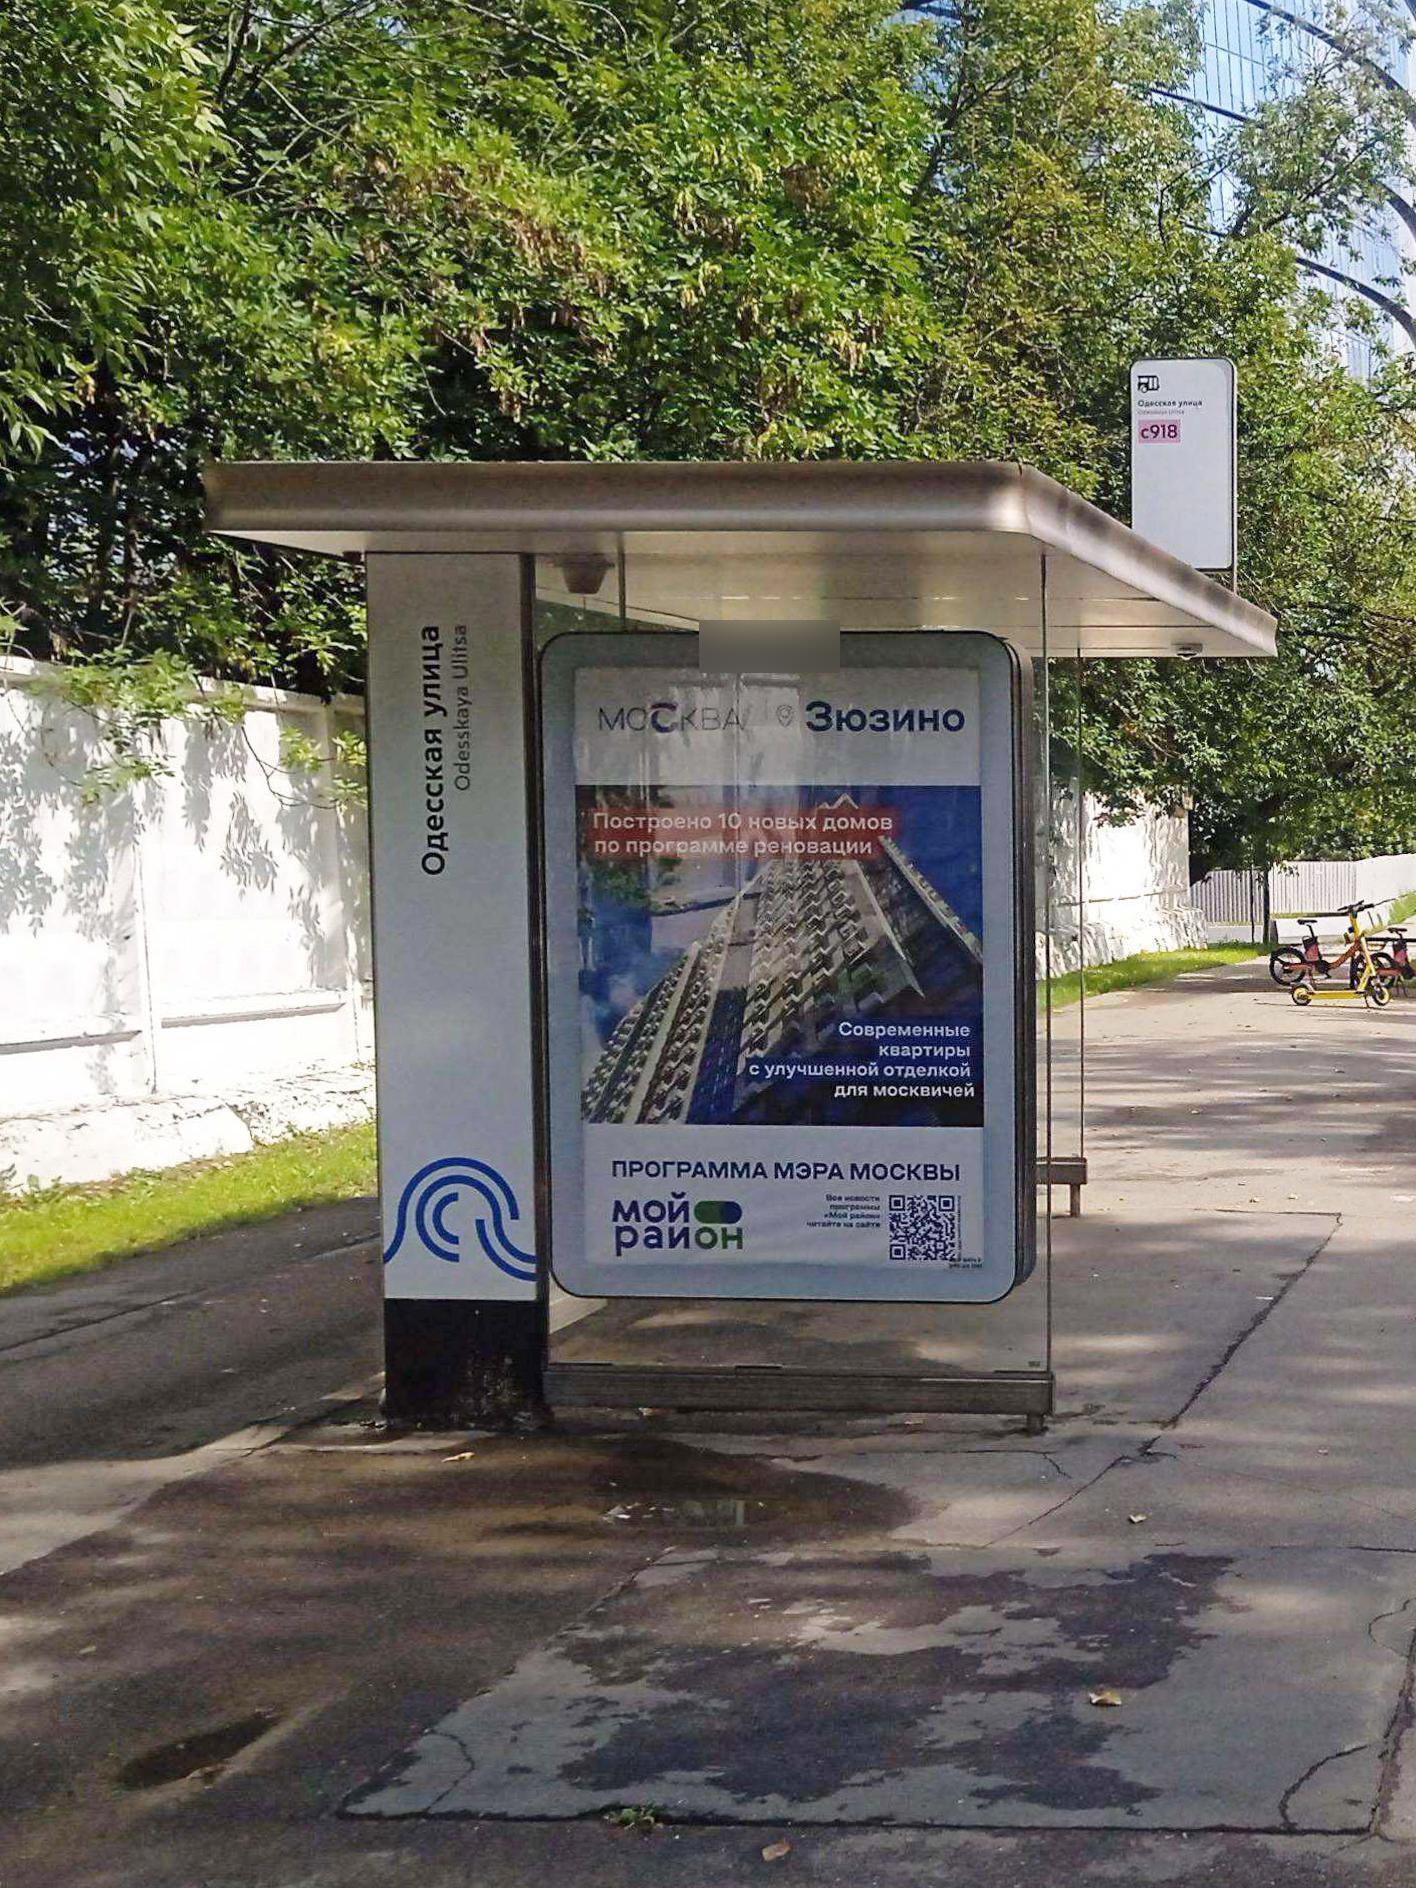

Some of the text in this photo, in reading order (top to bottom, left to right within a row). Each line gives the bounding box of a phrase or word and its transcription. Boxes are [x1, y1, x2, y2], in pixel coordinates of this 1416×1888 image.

[451, 625, 472, 791] Odesskaya Ulitsa
[805, 700, 965, 733] Зюзино
[421, 626, 449, 876] Одесская улица
[592, 812, 893, 834] Построено 10 новых домов
[594, 837, 872, 858] по программе реновации
[838, 1021, 972, 1041] Современные
[878, 1044, 971, 1060] квартиры
[749, 1062, 972, 1080] с улучшенной отделкой
[833, 1082, 976, 1098] для москвичей
[611, 1159, 961, 1182] ПРОГРАММА МЭРА МОСКВЫ
[611, 1191, 691, 1224] мой
